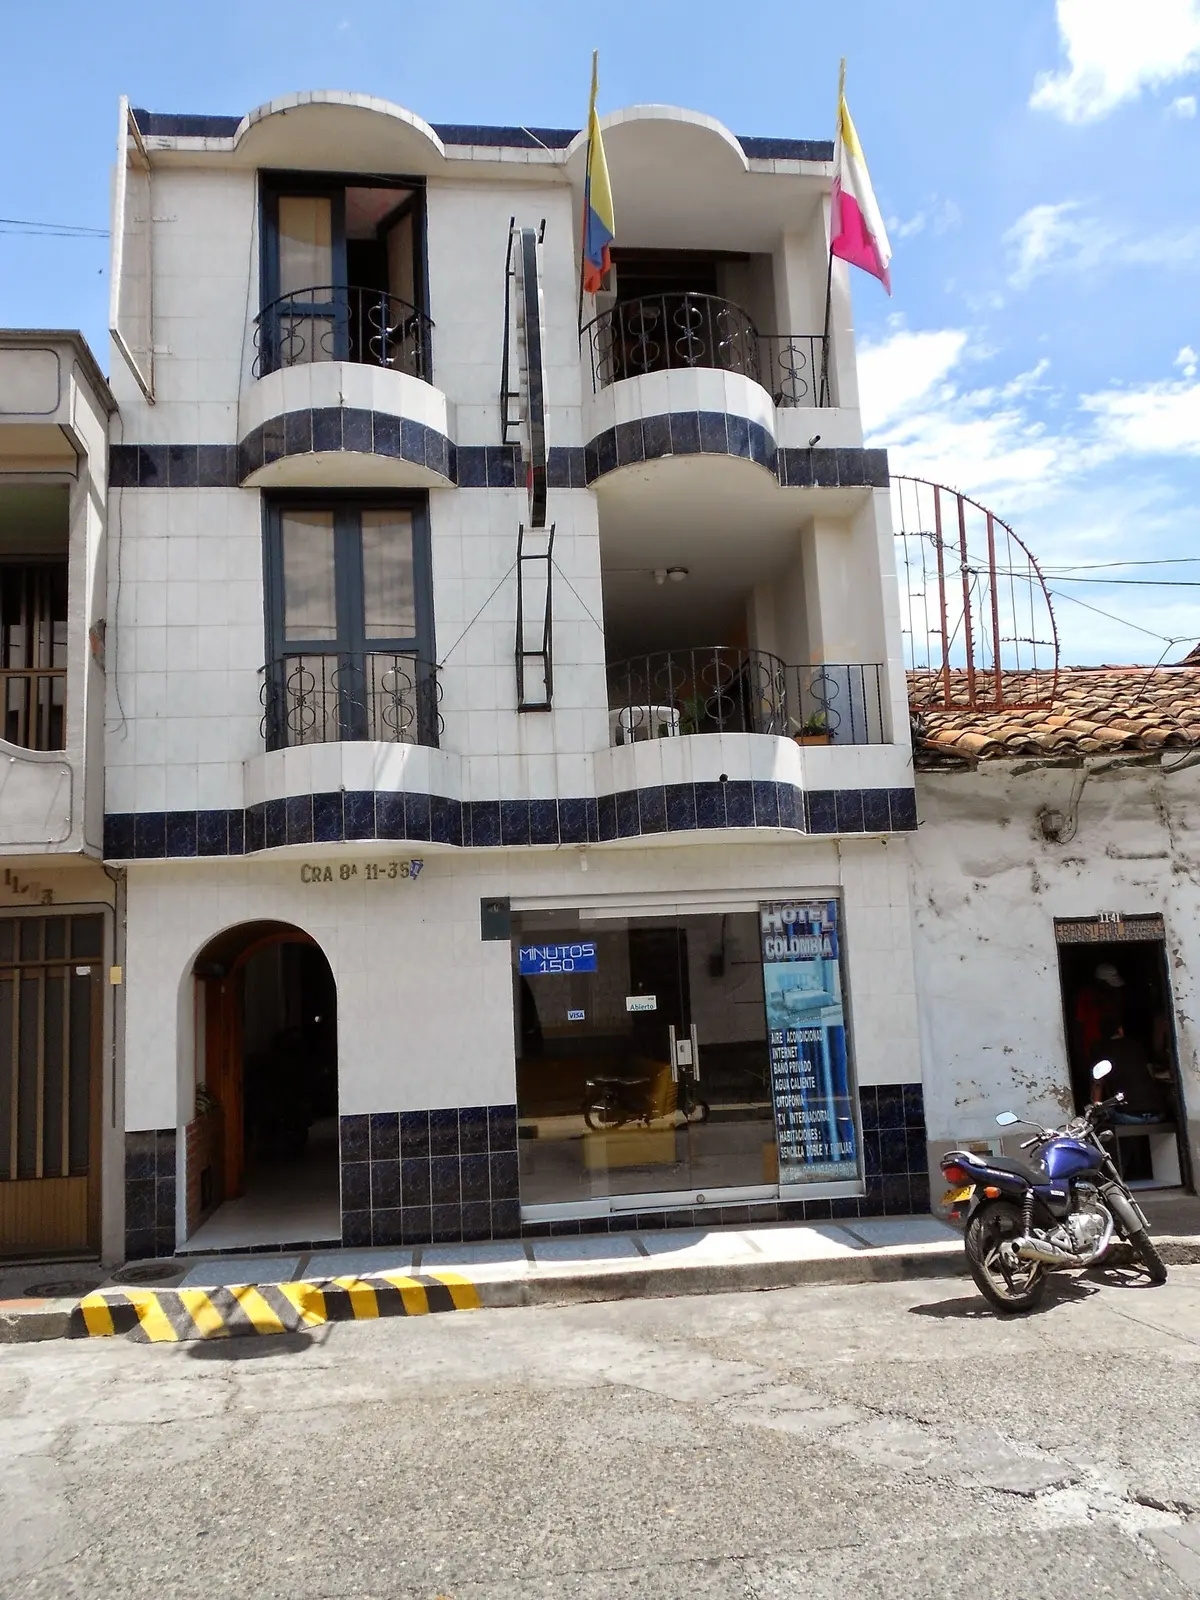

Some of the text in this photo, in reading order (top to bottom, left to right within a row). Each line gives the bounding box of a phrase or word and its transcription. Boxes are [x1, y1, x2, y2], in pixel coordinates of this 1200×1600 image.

[300, 863, 333, 883] CRA
[761, 904, 834, 932] HOTEL
[519, 943, 595, 961] MINUTOS
[765, 934, 834, 959] COLOMBIA
[540, 959, 574, 973] 150
[630, 1003, 655, 1011] Abierto
[772, 1046, 798, 1059] INTERNET
[789, 1060, 812, 1073] PRIVADO
[775, 1076, 816, 1091] AGUA CALIENTE
